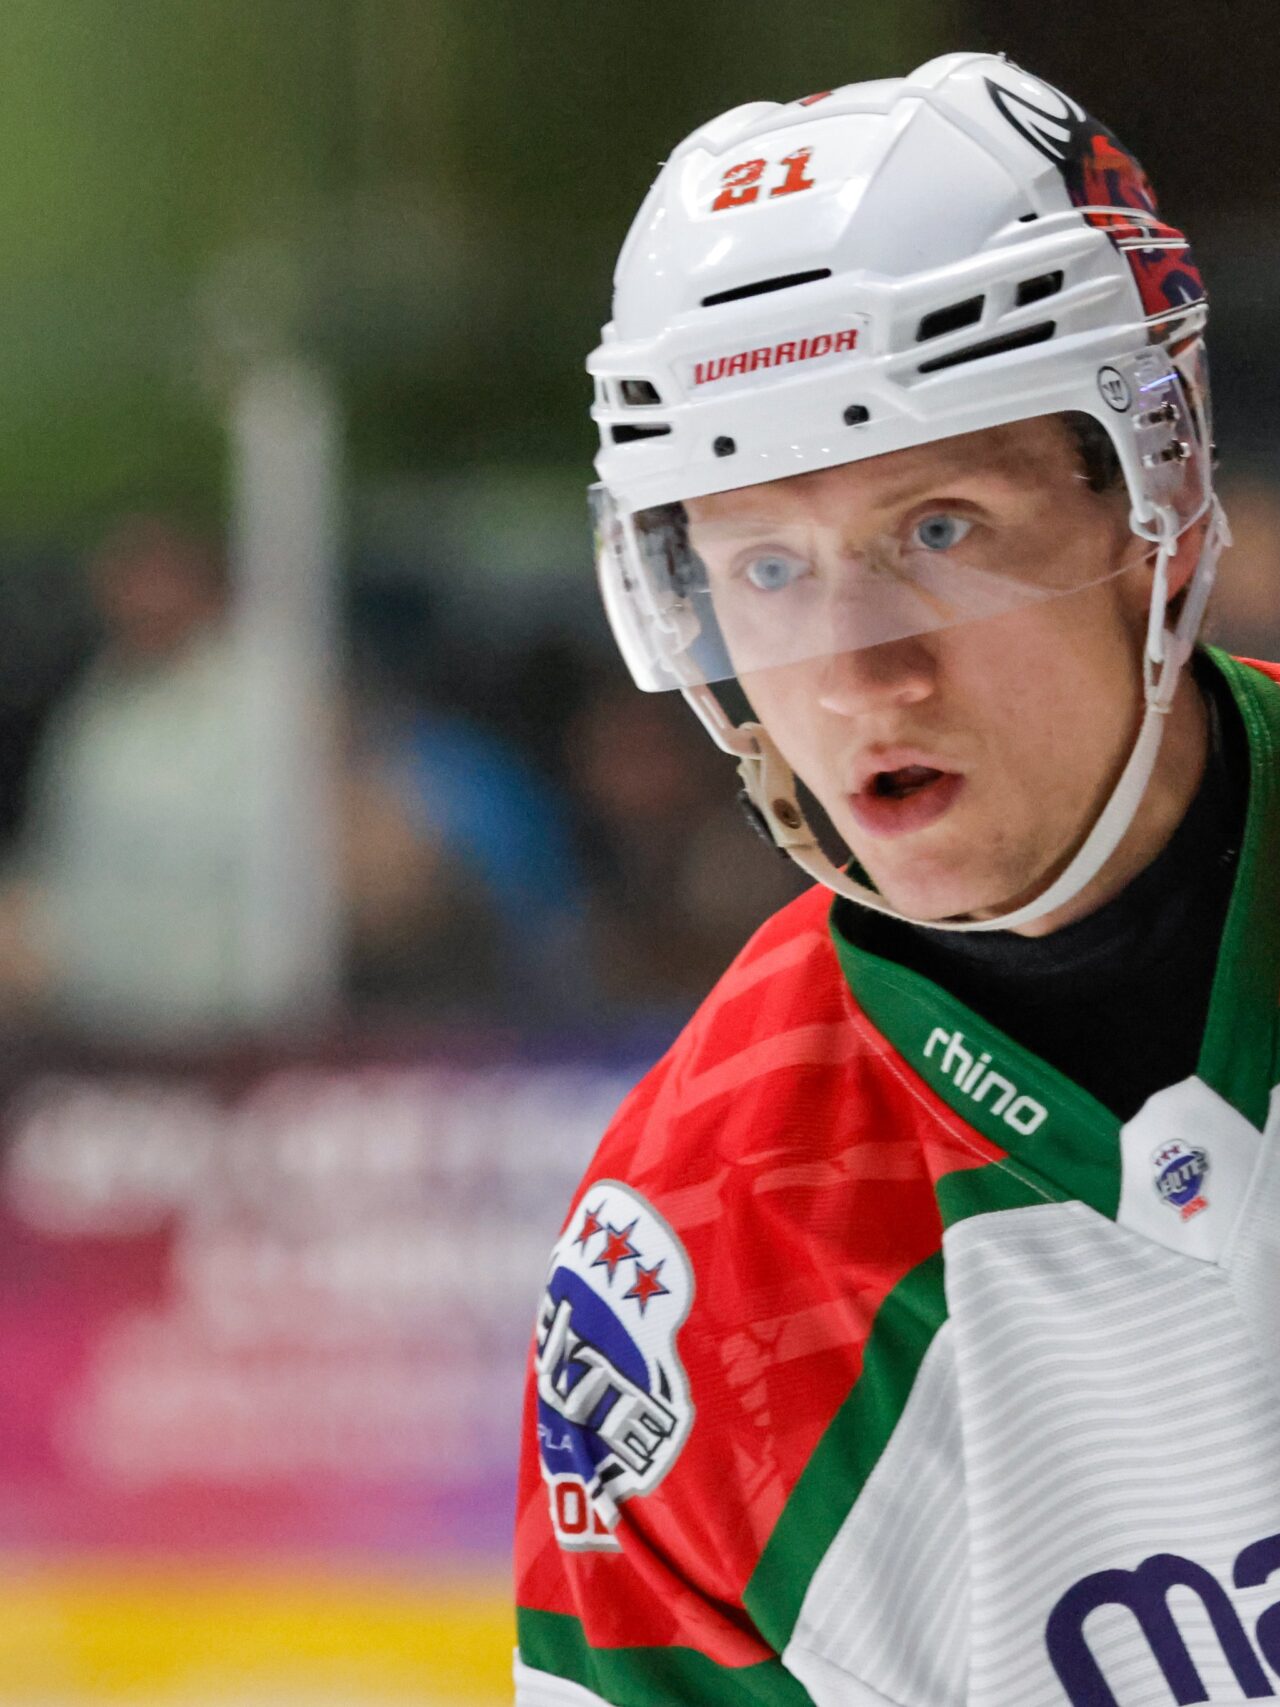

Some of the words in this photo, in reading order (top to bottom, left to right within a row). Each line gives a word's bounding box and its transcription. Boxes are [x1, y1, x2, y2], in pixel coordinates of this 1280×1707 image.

[711, 146, 816, 212] 21
[692, 329, 858, 385] WARRIOR
[923, 1027, 1049, 1136] rhino
